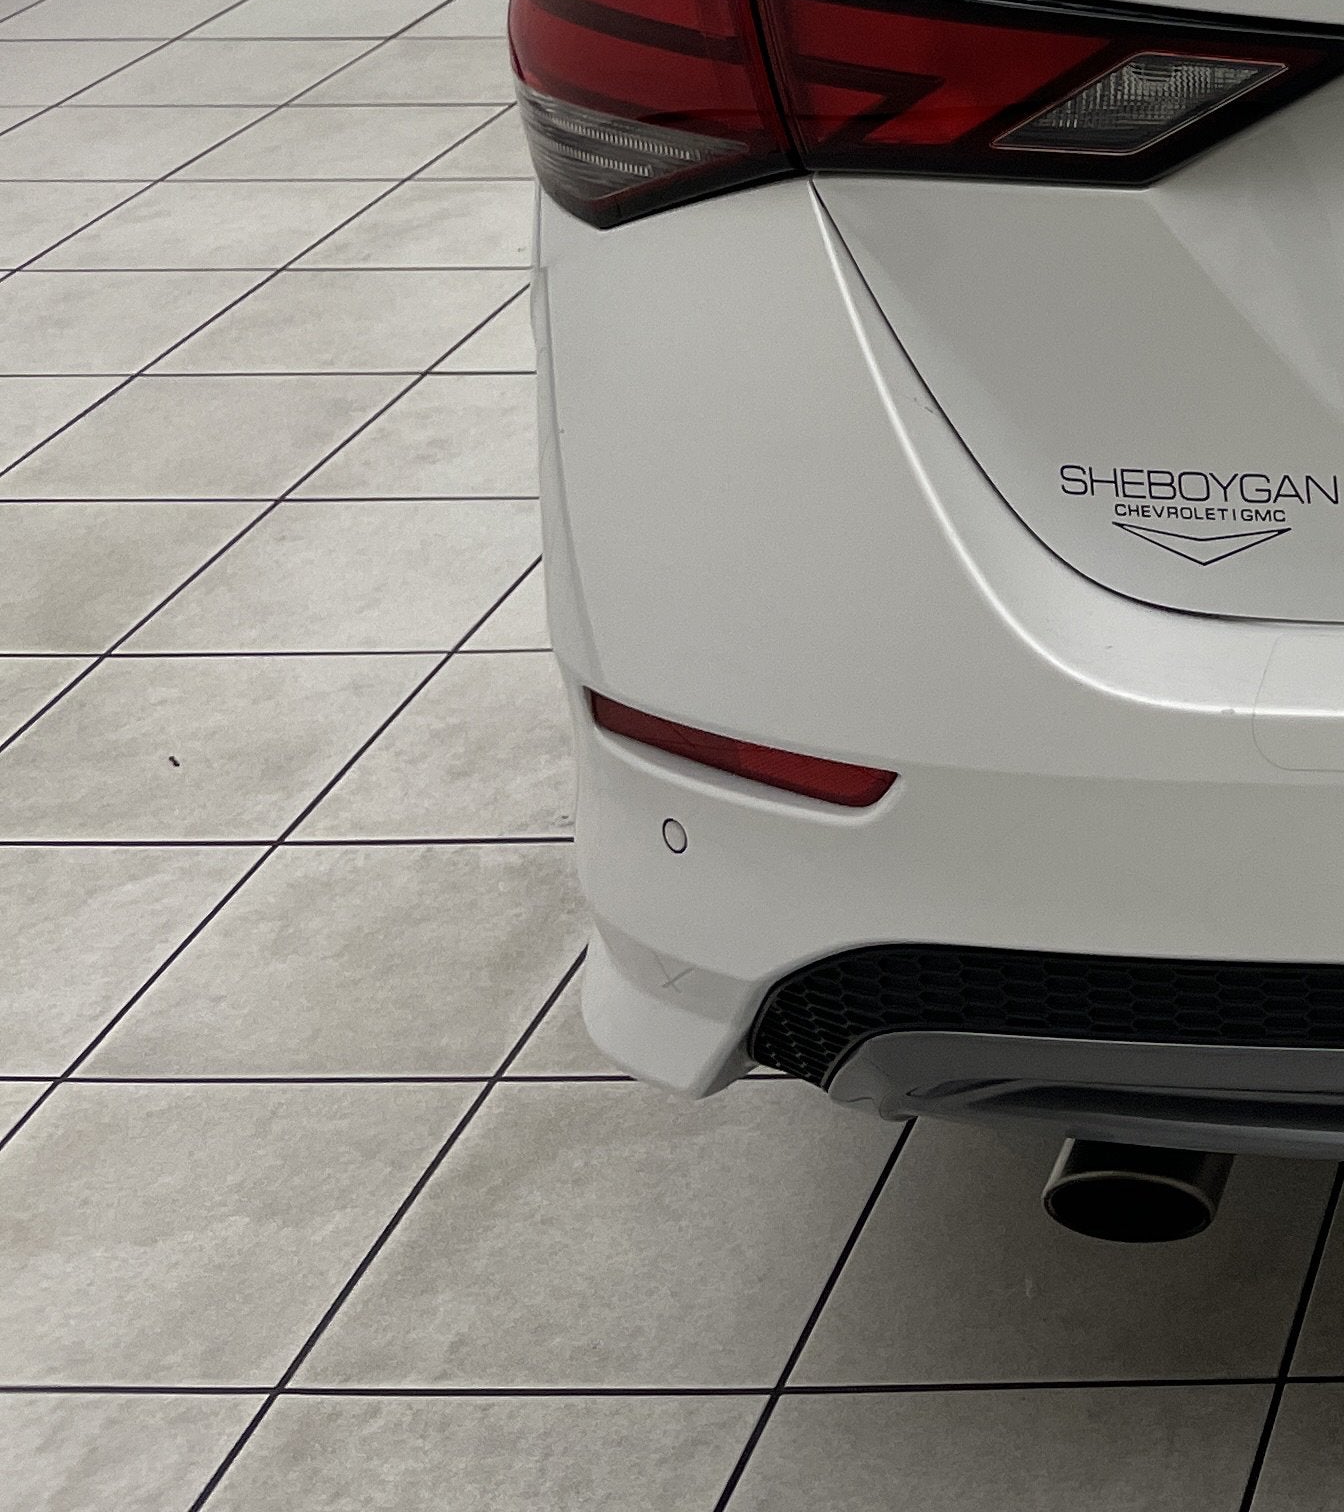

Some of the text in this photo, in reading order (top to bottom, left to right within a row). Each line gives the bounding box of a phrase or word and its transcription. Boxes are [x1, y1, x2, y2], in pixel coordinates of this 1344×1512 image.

[1059, 464, 1340, 505] SHEBOYGAN
[1114, 503, 1287, 523] CHEVROLET GMC
